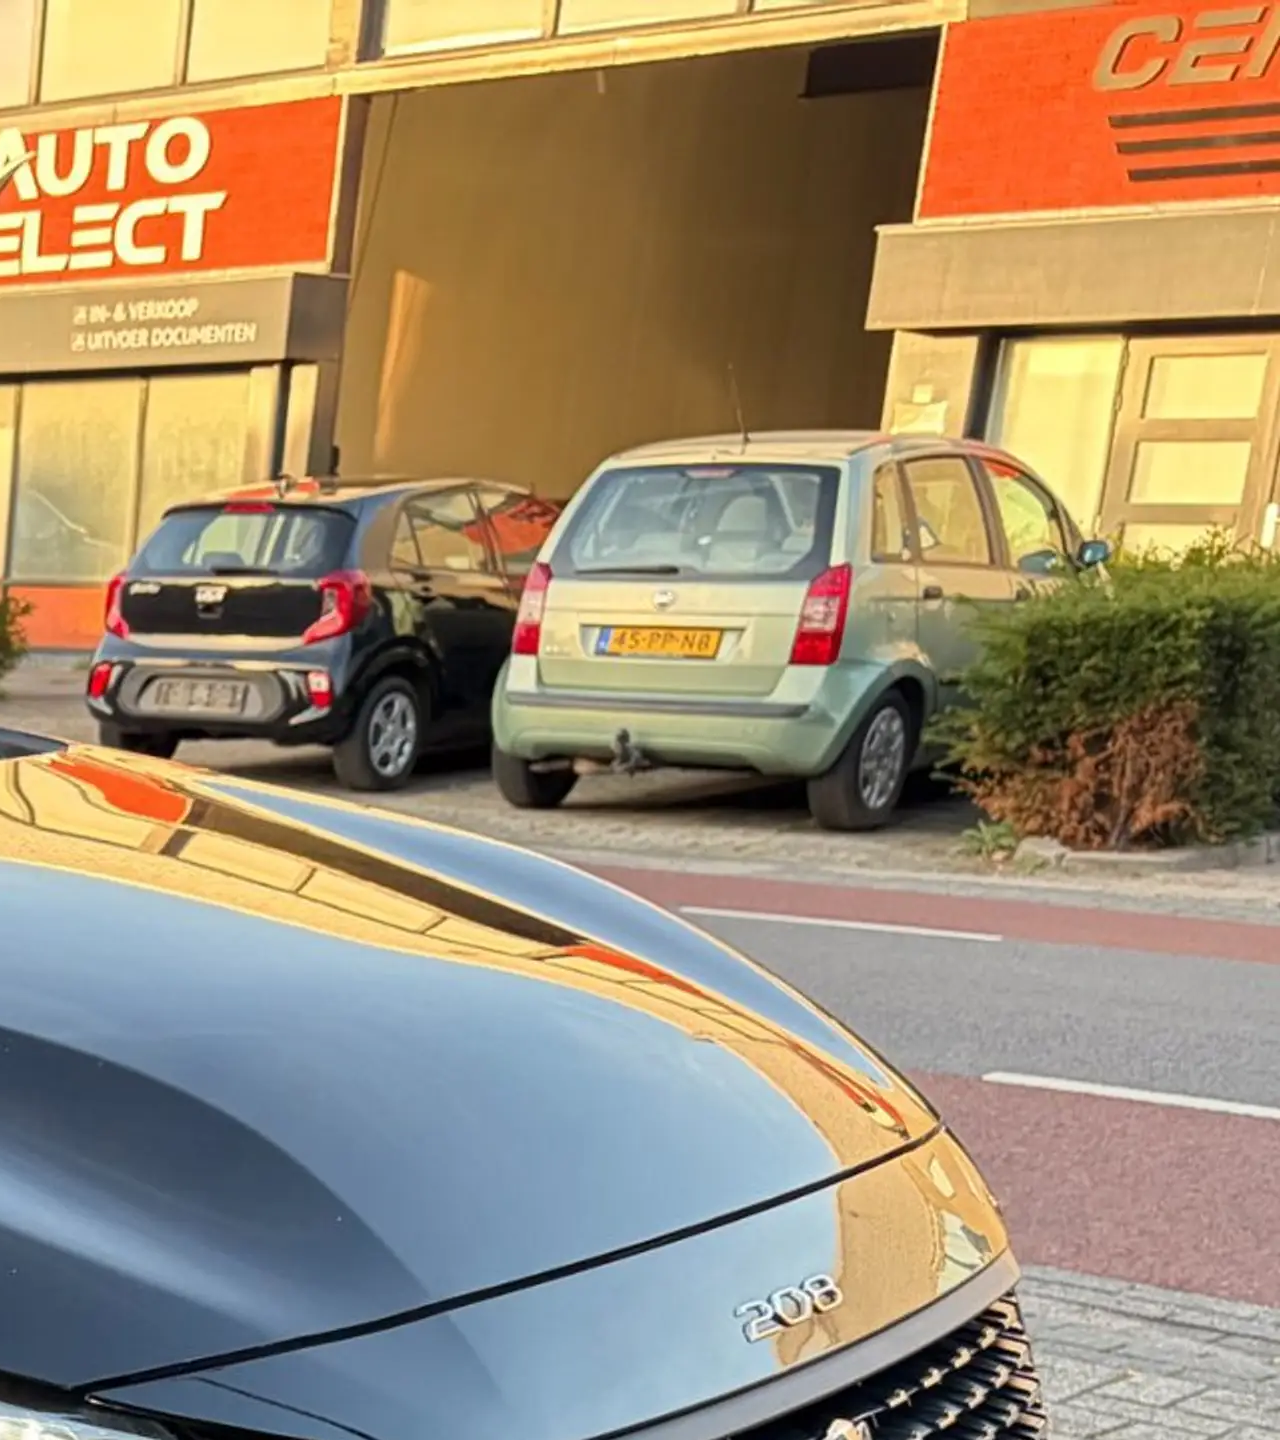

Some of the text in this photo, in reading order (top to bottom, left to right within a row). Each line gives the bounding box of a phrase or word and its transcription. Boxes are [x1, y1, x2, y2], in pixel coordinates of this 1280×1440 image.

[128, 297, 200, 321] VERKOOP
[87, 322, 258, 351] UITVOER DOCUMENTEN
[735, 1273, 844, 1343] 208
